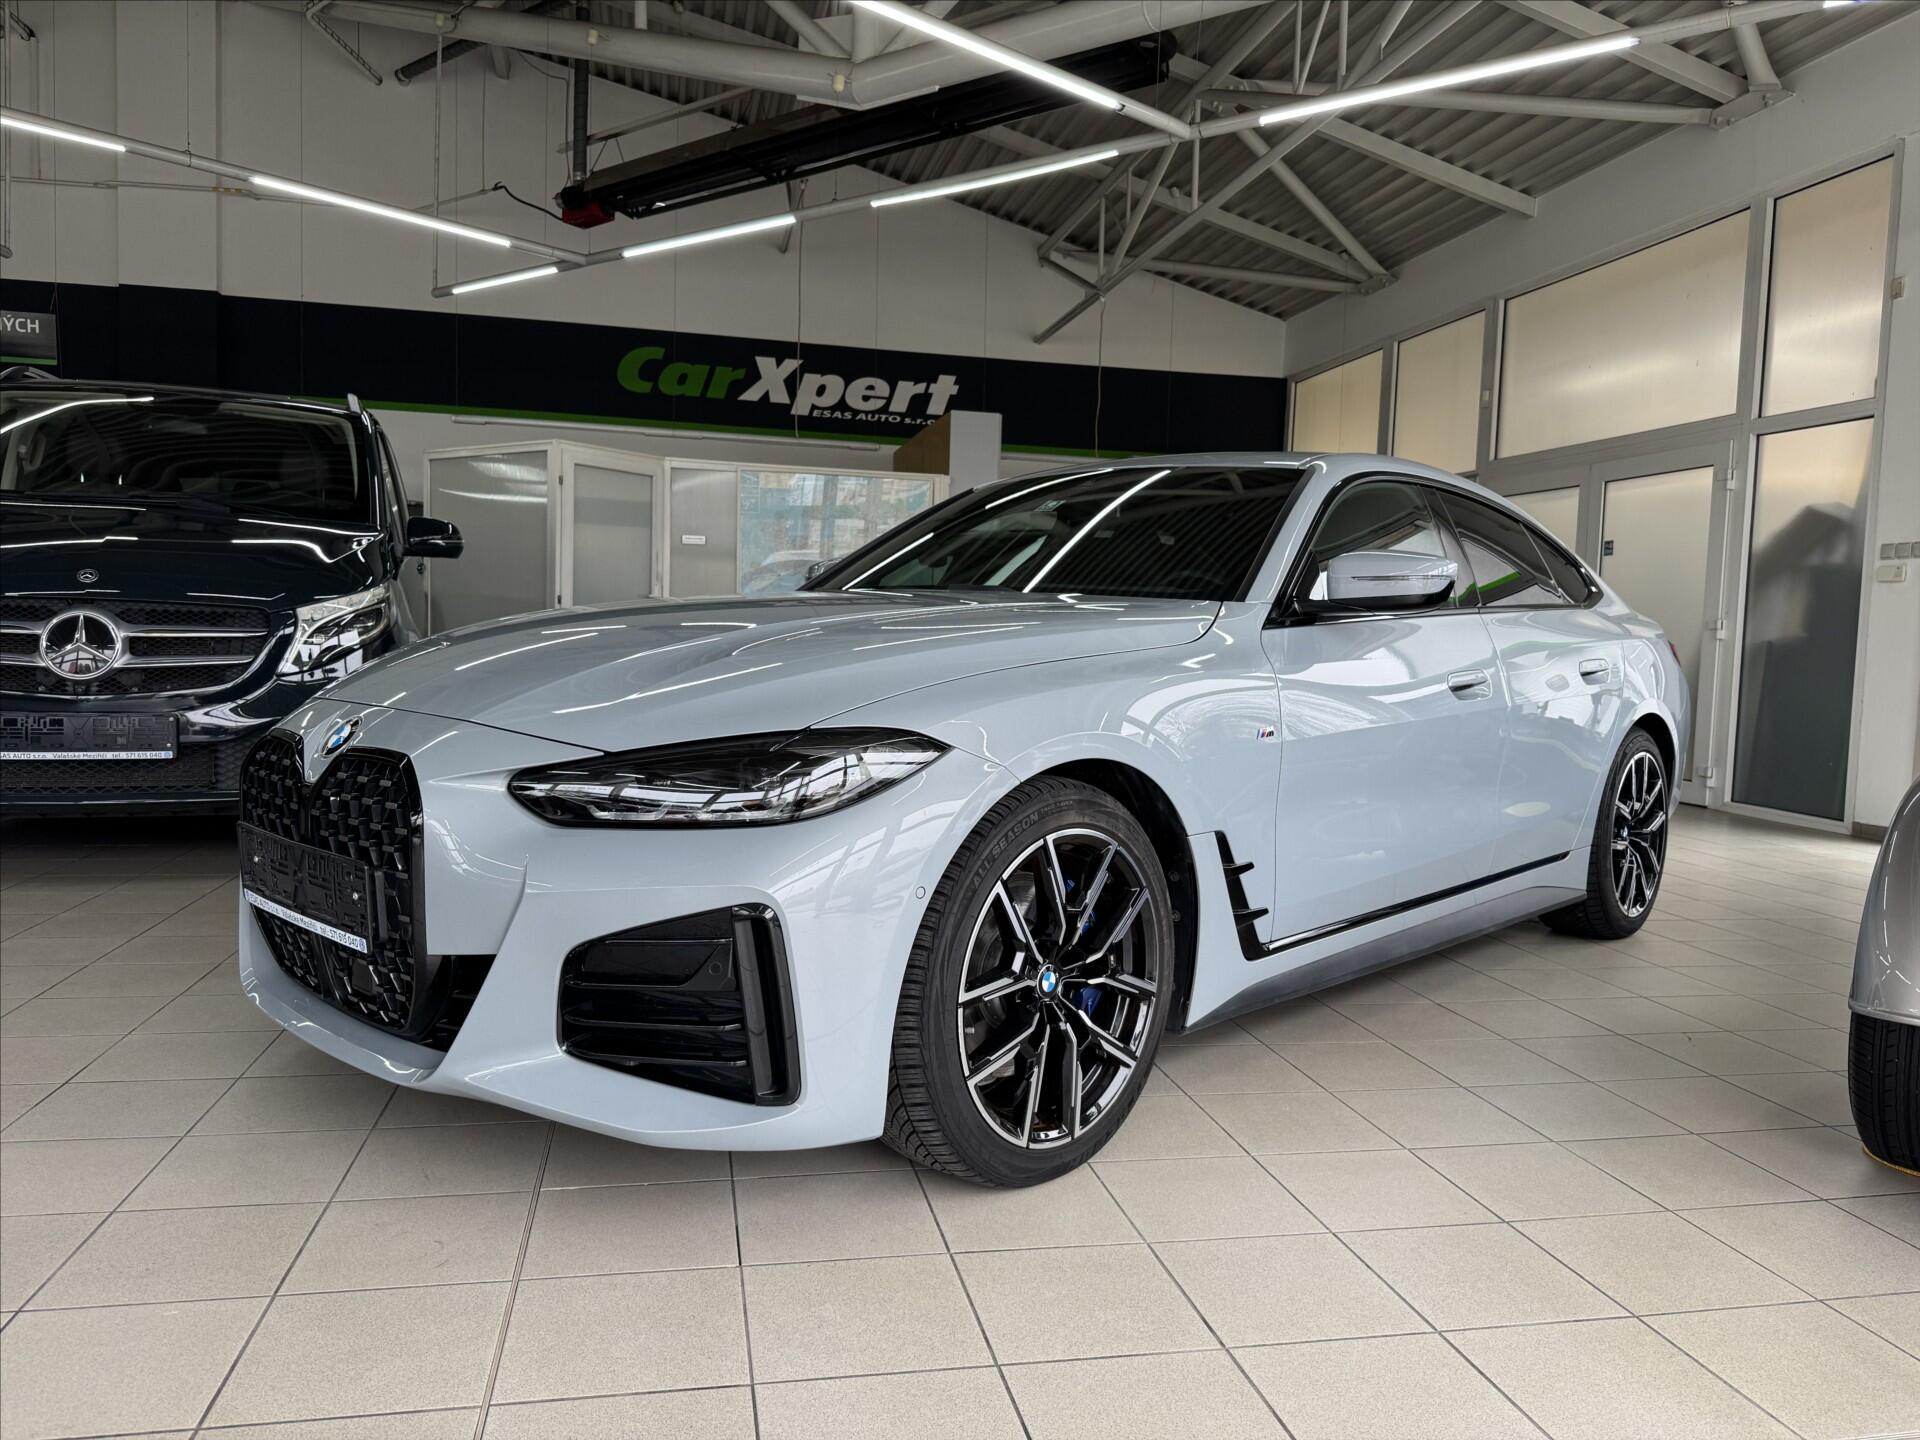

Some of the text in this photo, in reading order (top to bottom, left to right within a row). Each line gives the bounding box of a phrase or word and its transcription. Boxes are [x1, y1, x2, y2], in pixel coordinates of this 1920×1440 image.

[0, 314, 40, 333] ÝCH
[617, 346, 960, 416] CarXpert
[812, 409, 853, 420] ESAS
[855, 412, 901, 423] AUTO
[973, 814, 1039, 889] ALL SEASON
